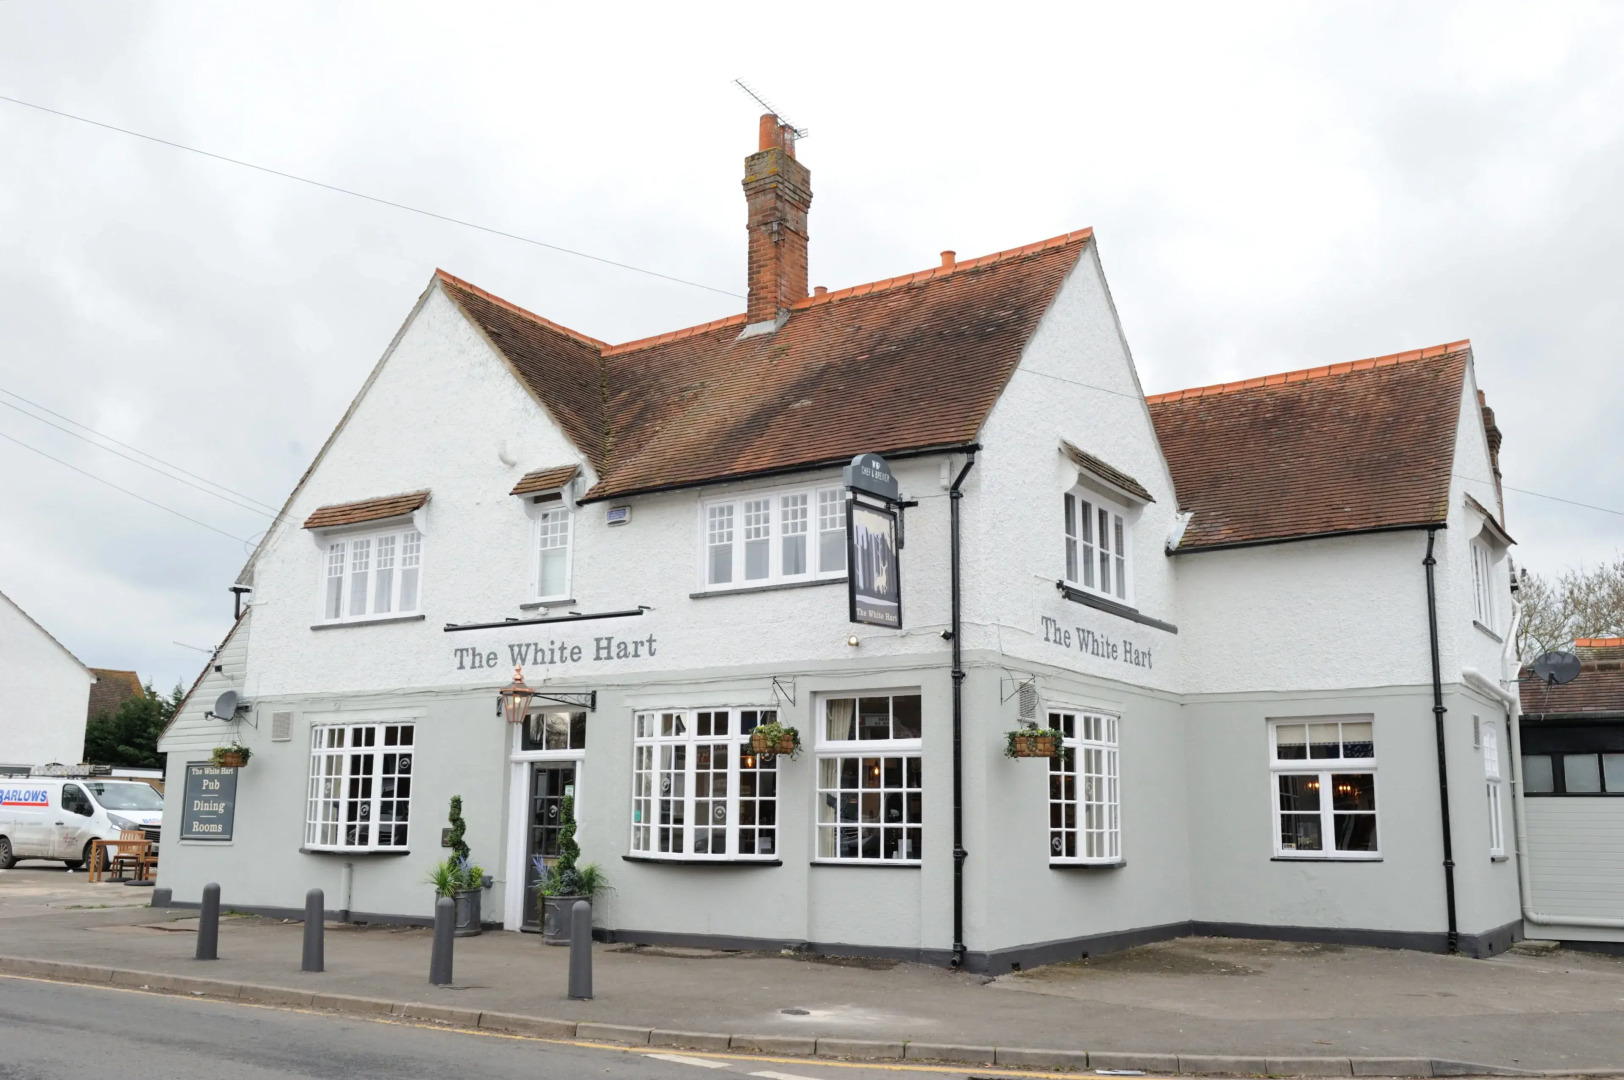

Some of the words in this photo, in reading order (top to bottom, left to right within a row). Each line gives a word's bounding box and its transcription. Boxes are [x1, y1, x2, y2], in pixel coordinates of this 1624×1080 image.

[856, 607, 867, 617] The
[868, 609, 884, 620] White
[885, 612, 898, 622] Hart
[1041, 615, 1071, 648] The
[1075, 627, 1118, 660] White
[1123, 640, 1153, 669] Hart
[454, 647, 498, 670] The
[508, 640, 582, 666] White
[593, 633, 657, 661] Hart
[204, 767, 220, 775] White
[220, 767, 234, 775] Hart
[202, 779, 220, 790] Pub
[193, 800, 226, 814] Dining
[192, 821, 223, 832] Rooms
